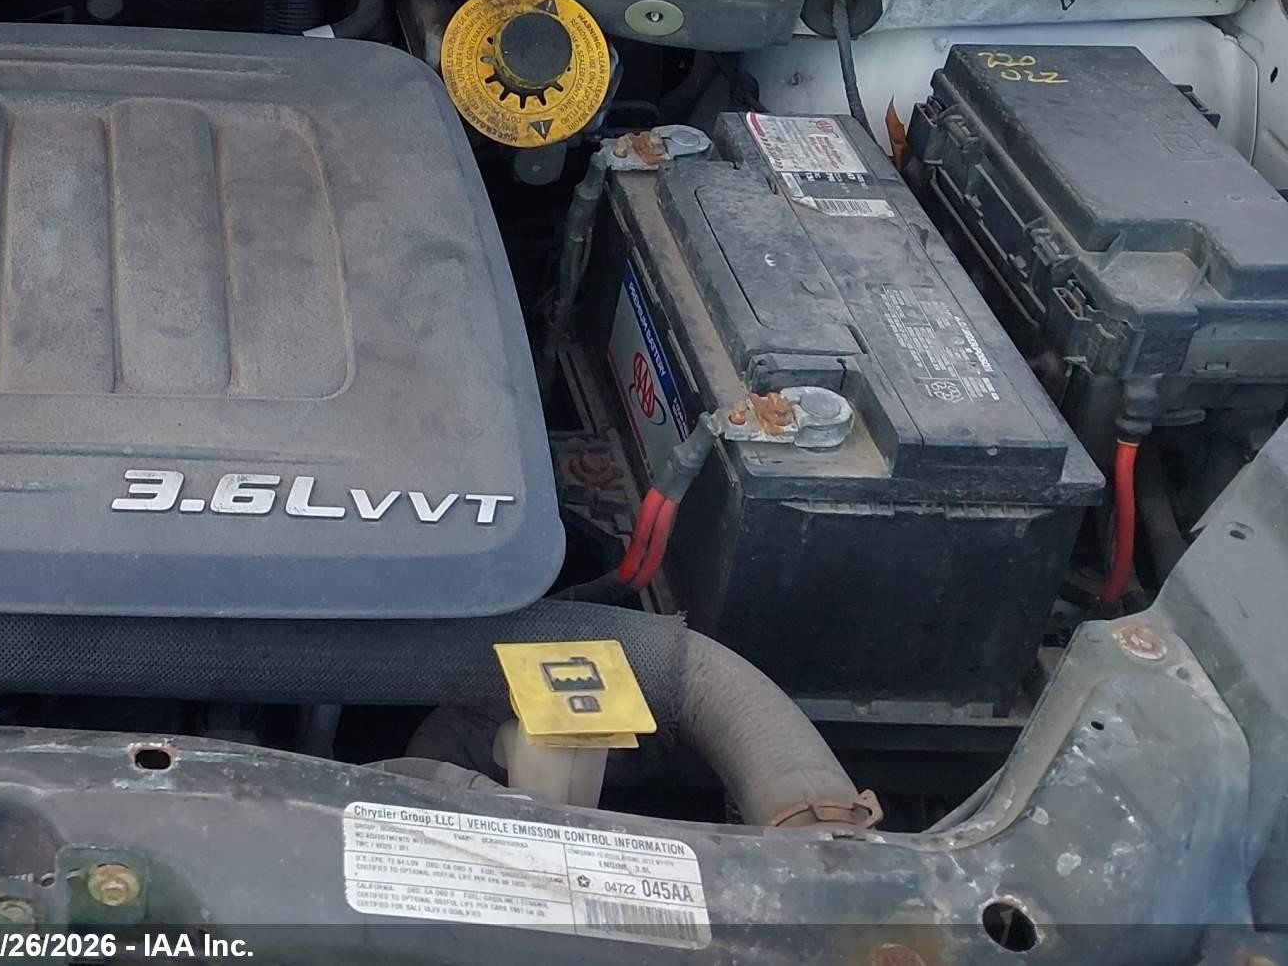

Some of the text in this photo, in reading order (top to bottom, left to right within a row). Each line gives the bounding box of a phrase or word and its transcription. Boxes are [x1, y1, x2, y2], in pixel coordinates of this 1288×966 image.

[576, 50, 586, 77] SEALED
[597, 51, 606, 74] CLEAN
[628, 282, 666, 377] PREMIUM BATTERY
[111, 469, 515, 524] 3.6L VVT
[354, 805, 455, 827] Chrysler Group LLC
[467, 819, 686, 856] VEHICLE EMISSION CONTROL INFORMATION
[604, 879, 694, 903] 04722 045AA
